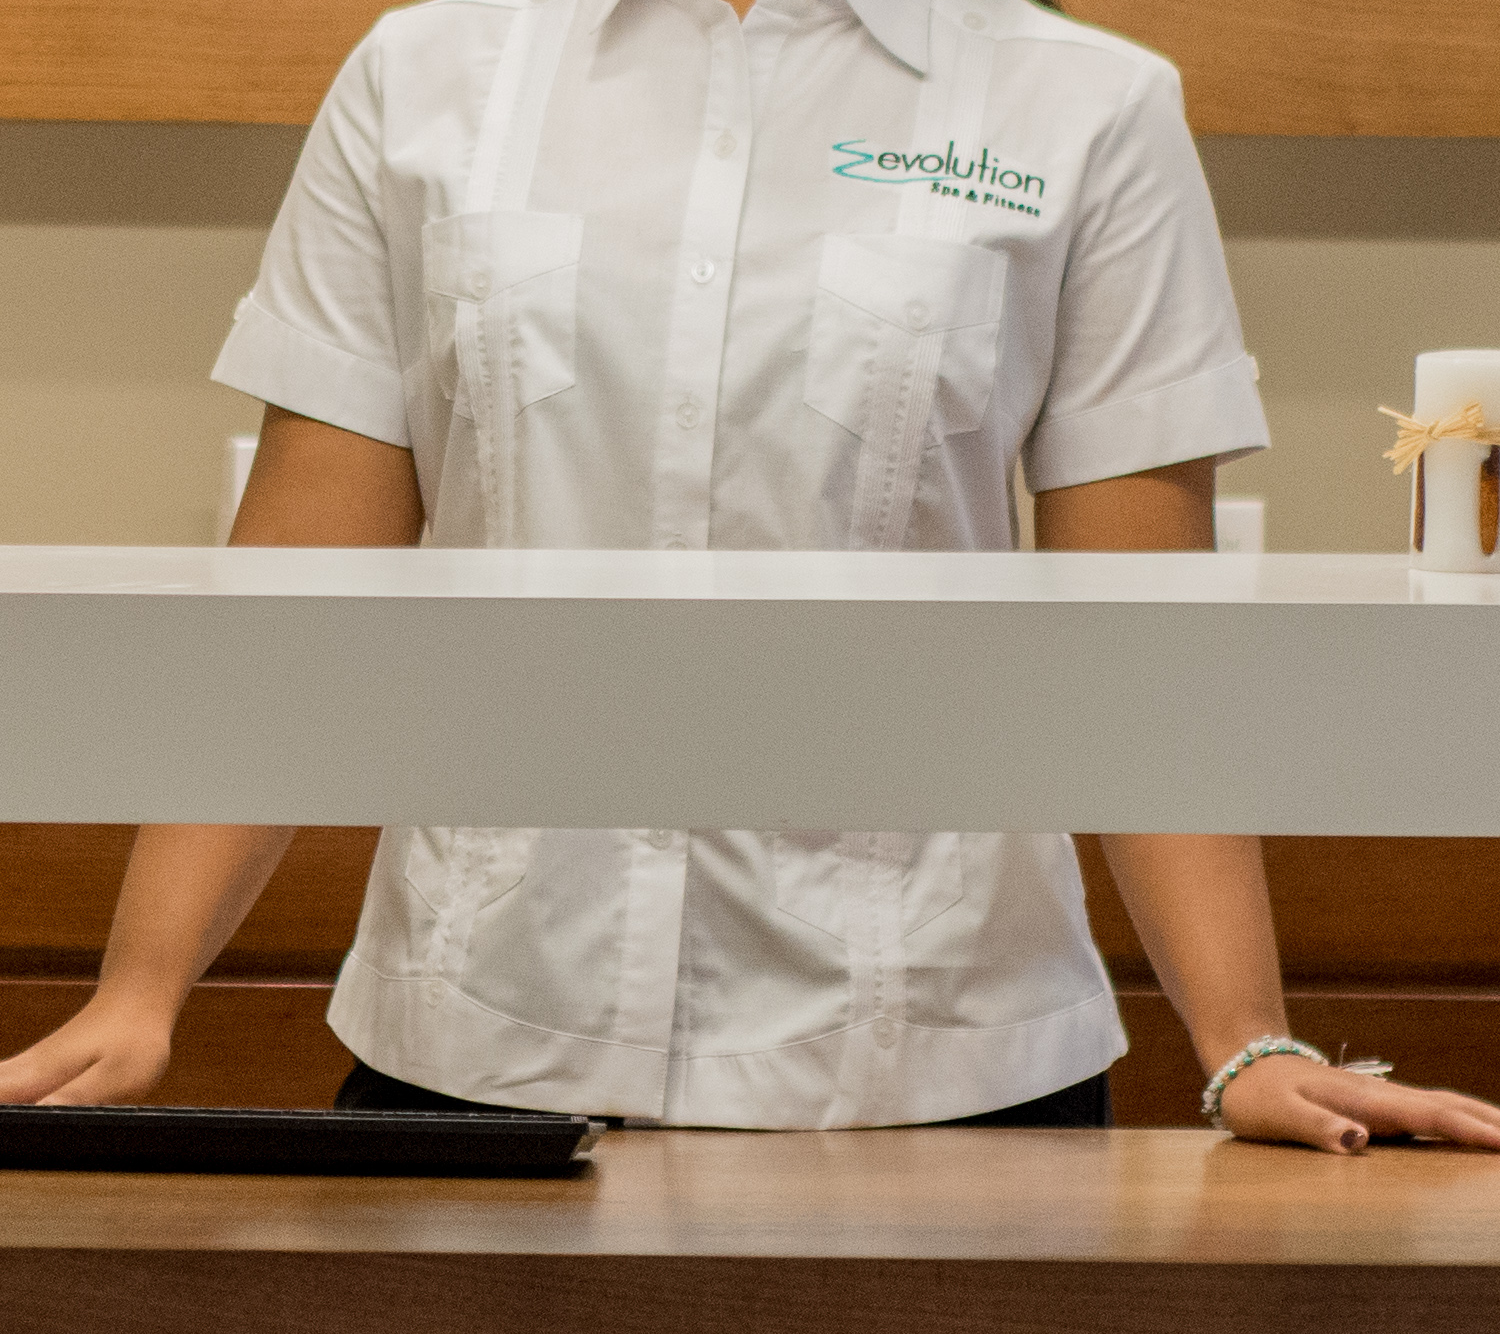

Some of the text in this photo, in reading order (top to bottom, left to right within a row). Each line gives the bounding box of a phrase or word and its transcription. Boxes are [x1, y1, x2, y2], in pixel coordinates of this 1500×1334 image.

[877, 140, 1046, 199] evolution
[930, 182, 1042, 219] Spa & Fitness
